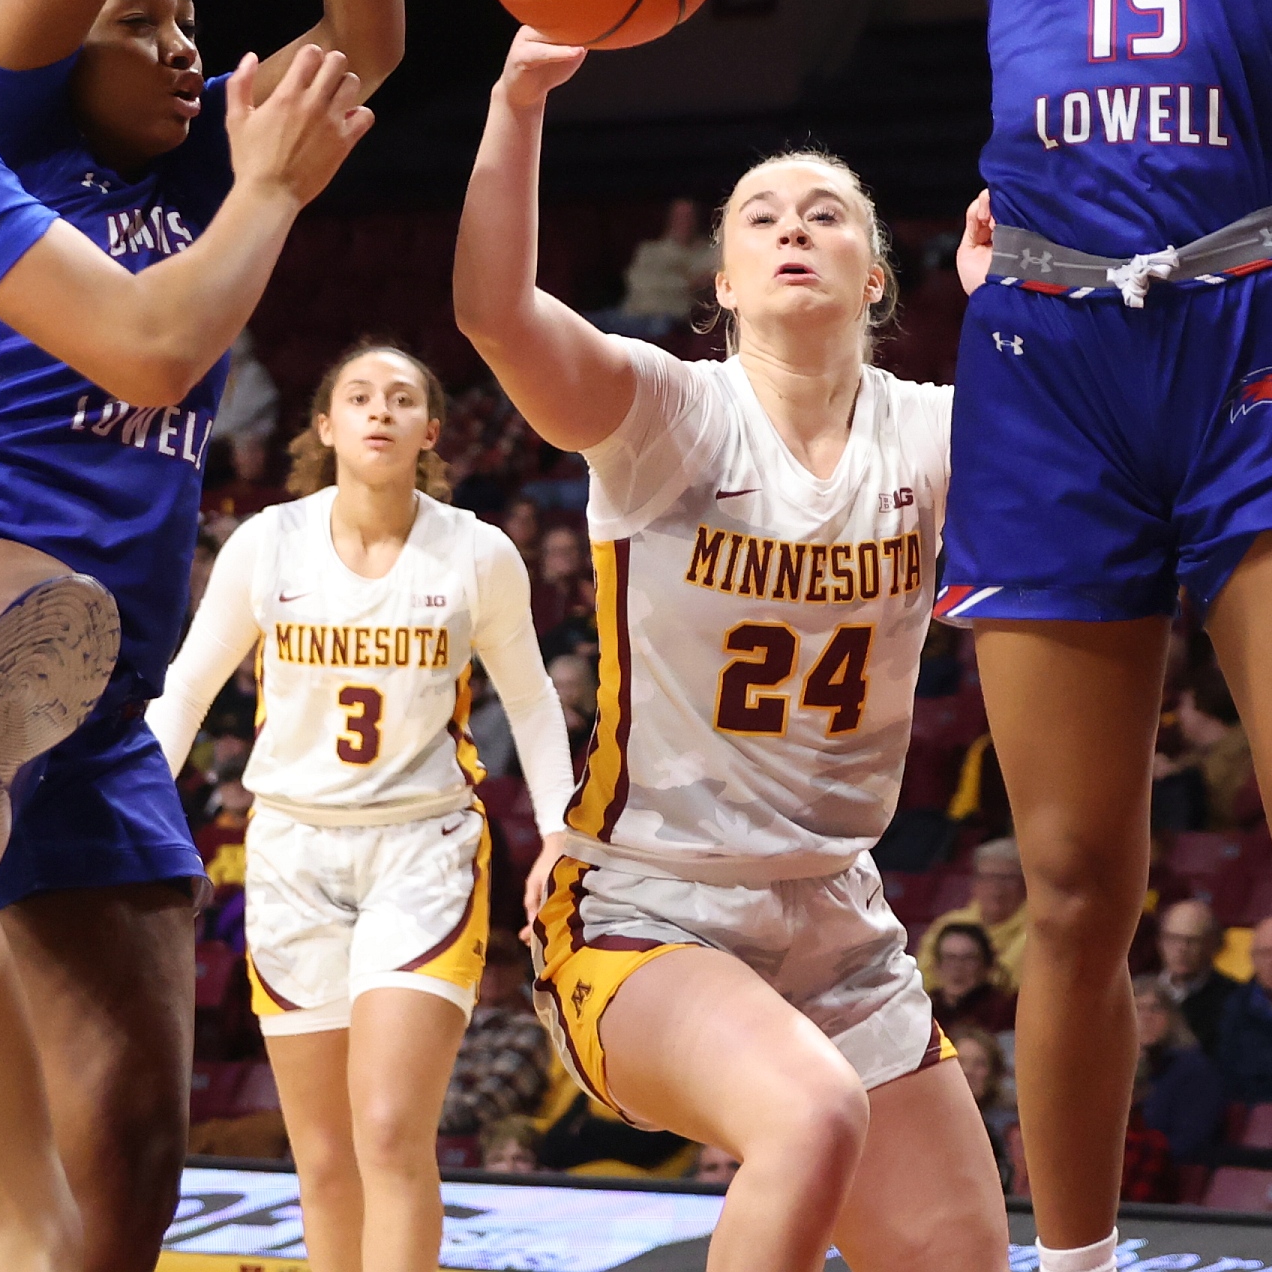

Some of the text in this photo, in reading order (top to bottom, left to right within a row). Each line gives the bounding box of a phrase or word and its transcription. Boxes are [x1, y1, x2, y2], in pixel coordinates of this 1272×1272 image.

[1035, 86, 1229, 150] LOWELL
[107, 206, 194, 257] UMAS
[684, 522, 921, 605] MINNESOTA
[275, 621, 449, 668] MINNESOTA
[713, 619, 875, 737] 24
[336, 682, 384, 767] 3
